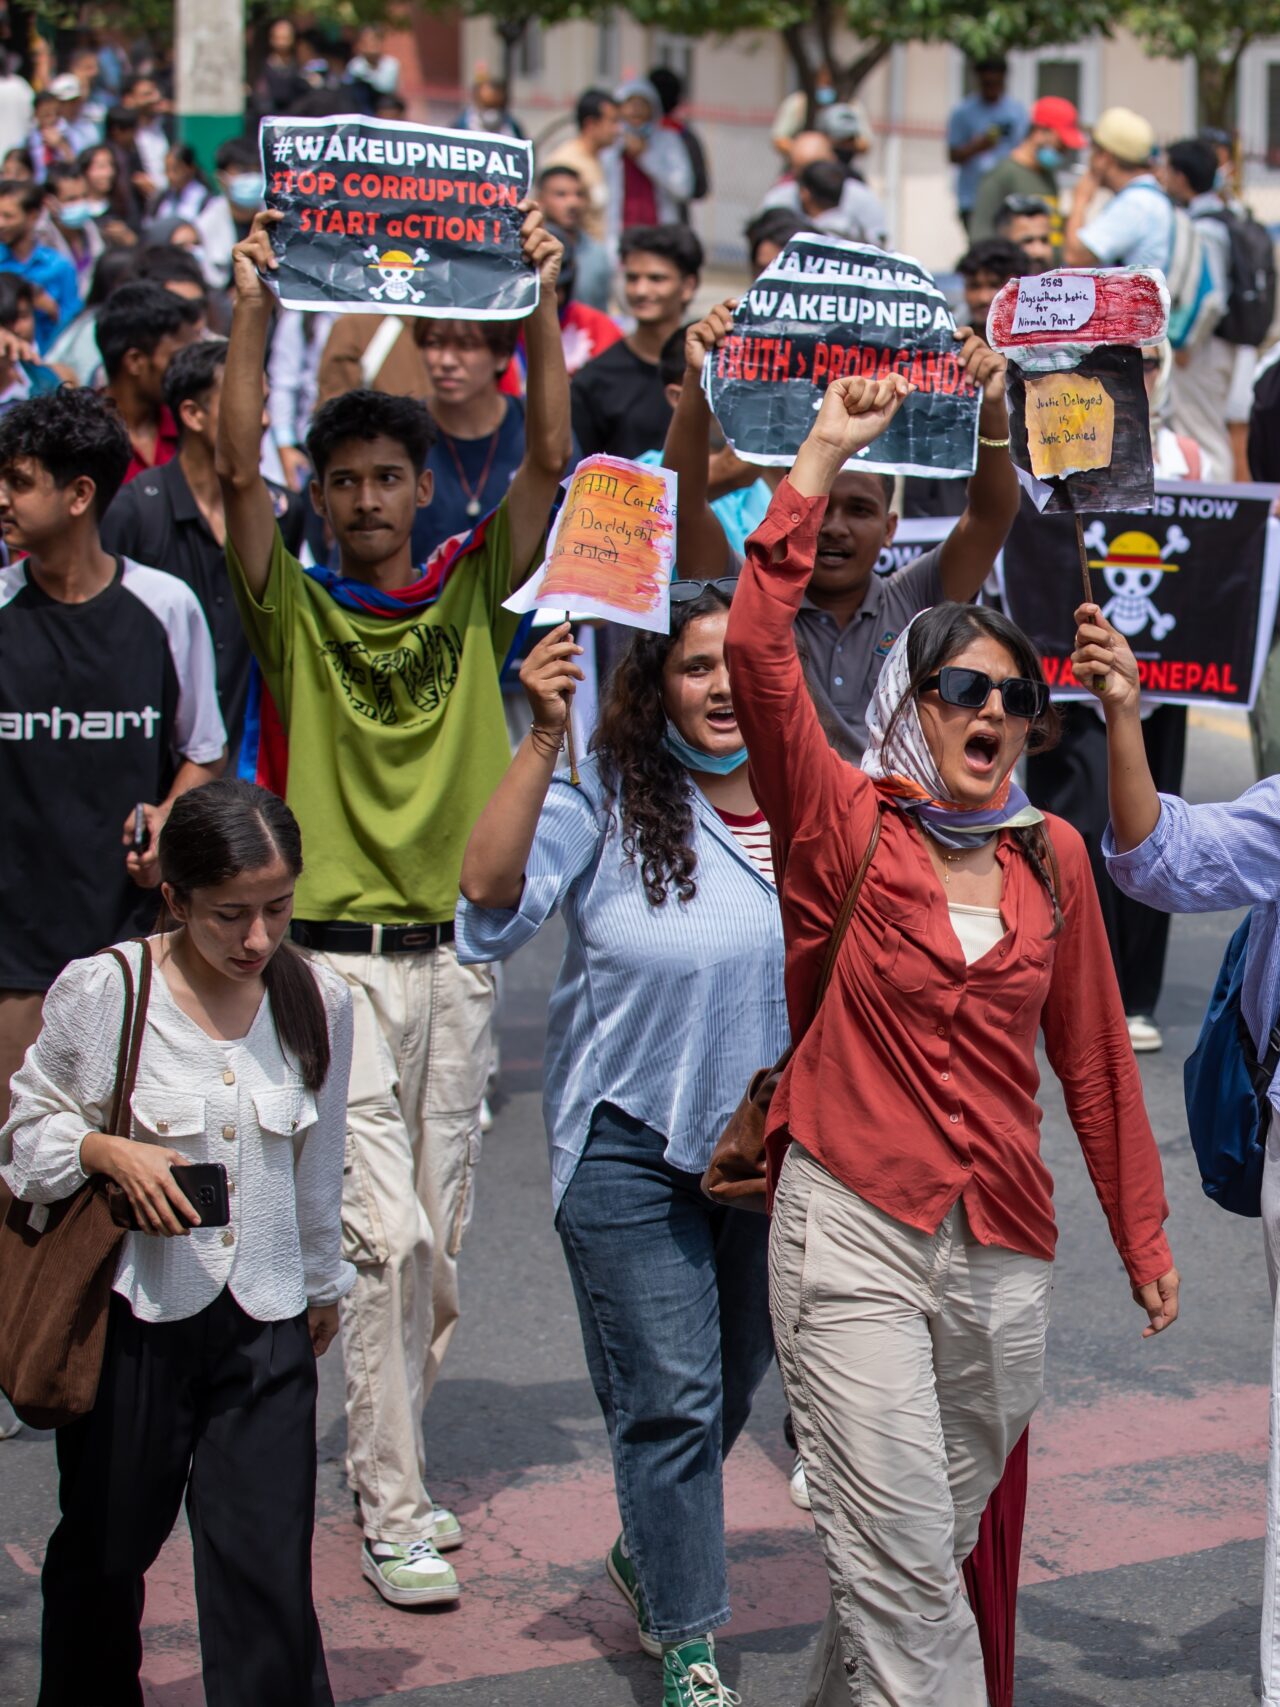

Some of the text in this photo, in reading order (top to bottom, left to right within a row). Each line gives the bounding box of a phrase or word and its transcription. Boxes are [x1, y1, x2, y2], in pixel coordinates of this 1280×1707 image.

[273, 135, 523, 179] #WAKEUPNEPAL
[271, 171, 518, 207] STOP CORRUPTION
[299, 208, 380, 236] START
[1034, 303, 1049, 313] for
[1049, 312, 1076, 328] Pant
[717, 335, 792, 383] TRUTH
[1178, 496, 1239, 520] NOW
